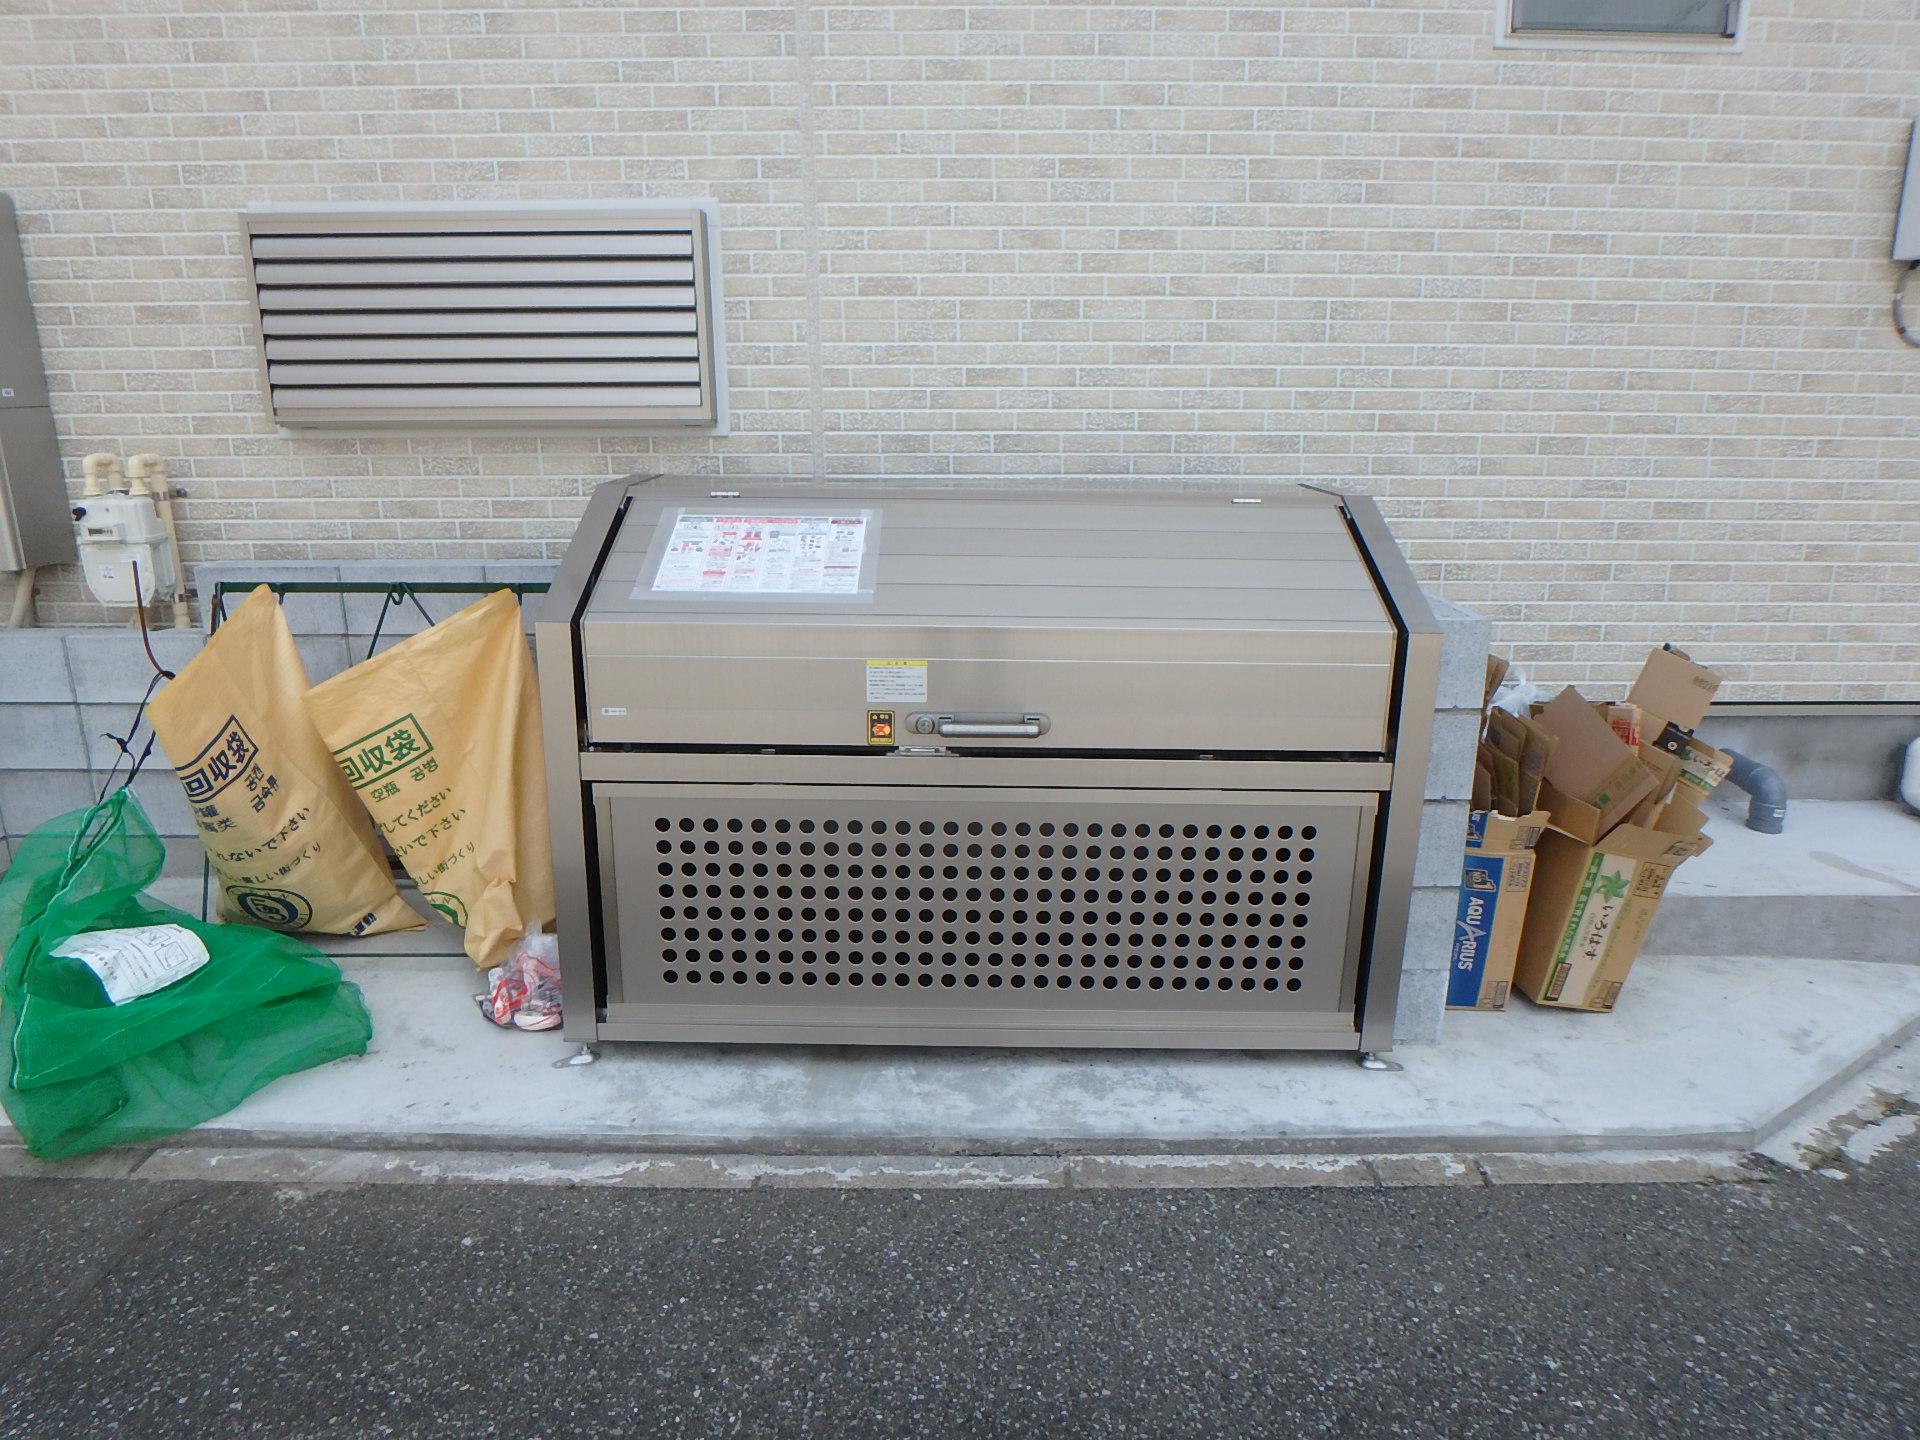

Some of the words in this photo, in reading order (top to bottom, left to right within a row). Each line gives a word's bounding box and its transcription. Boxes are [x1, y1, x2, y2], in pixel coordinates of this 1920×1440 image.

[180, 731, 250, 797] 回収袋
[337, 729, 420, 783] 回収袋
[379, 787, 451, 834] してください
[1456, 896, 1487, 972] AQUARIUS
